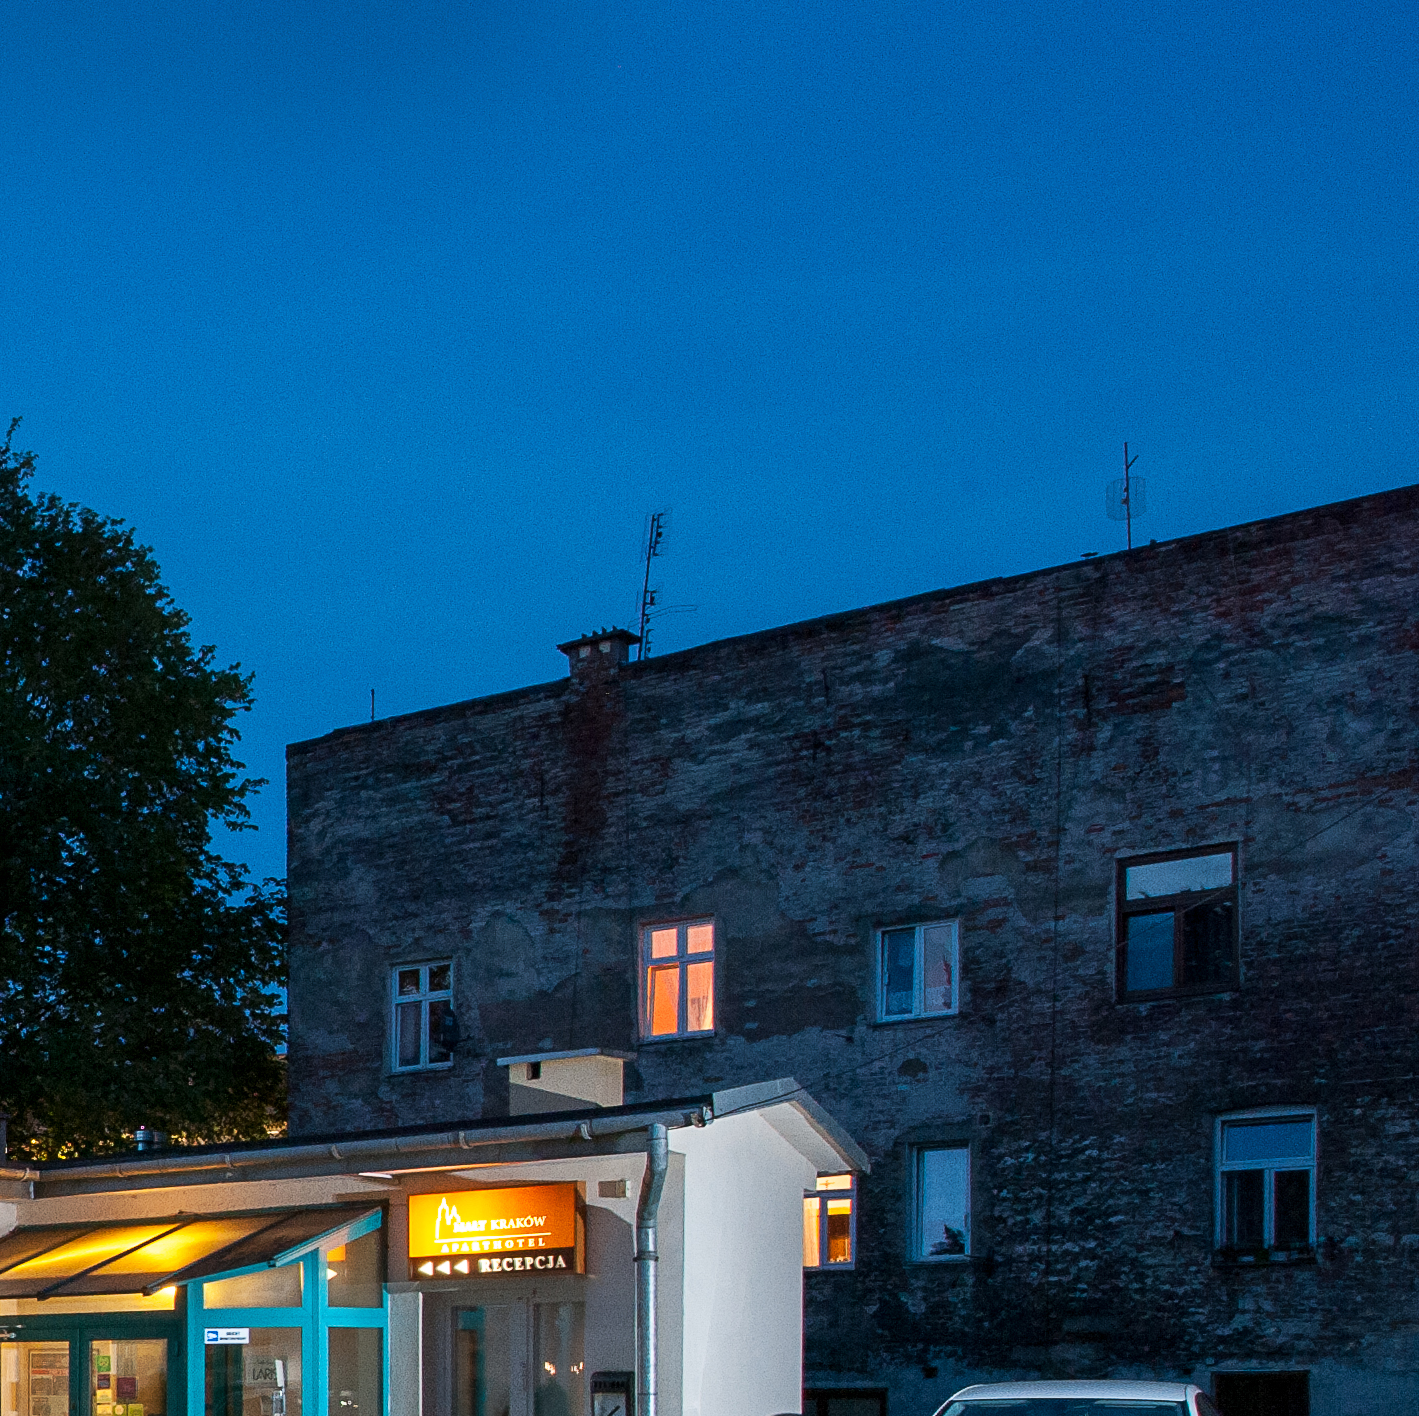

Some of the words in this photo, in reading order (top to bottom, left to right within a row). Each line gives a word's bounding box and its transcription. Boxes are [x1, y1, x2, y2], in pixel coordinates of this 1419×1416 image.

[453, 1219, 488, 1233] MAŁY
[490, 1215, 547, 1230] KRAKÓW
[441, 1237, 545, 1253] APARTHOTEL
[478, 1254, 566, 1274] RECEPCJA
